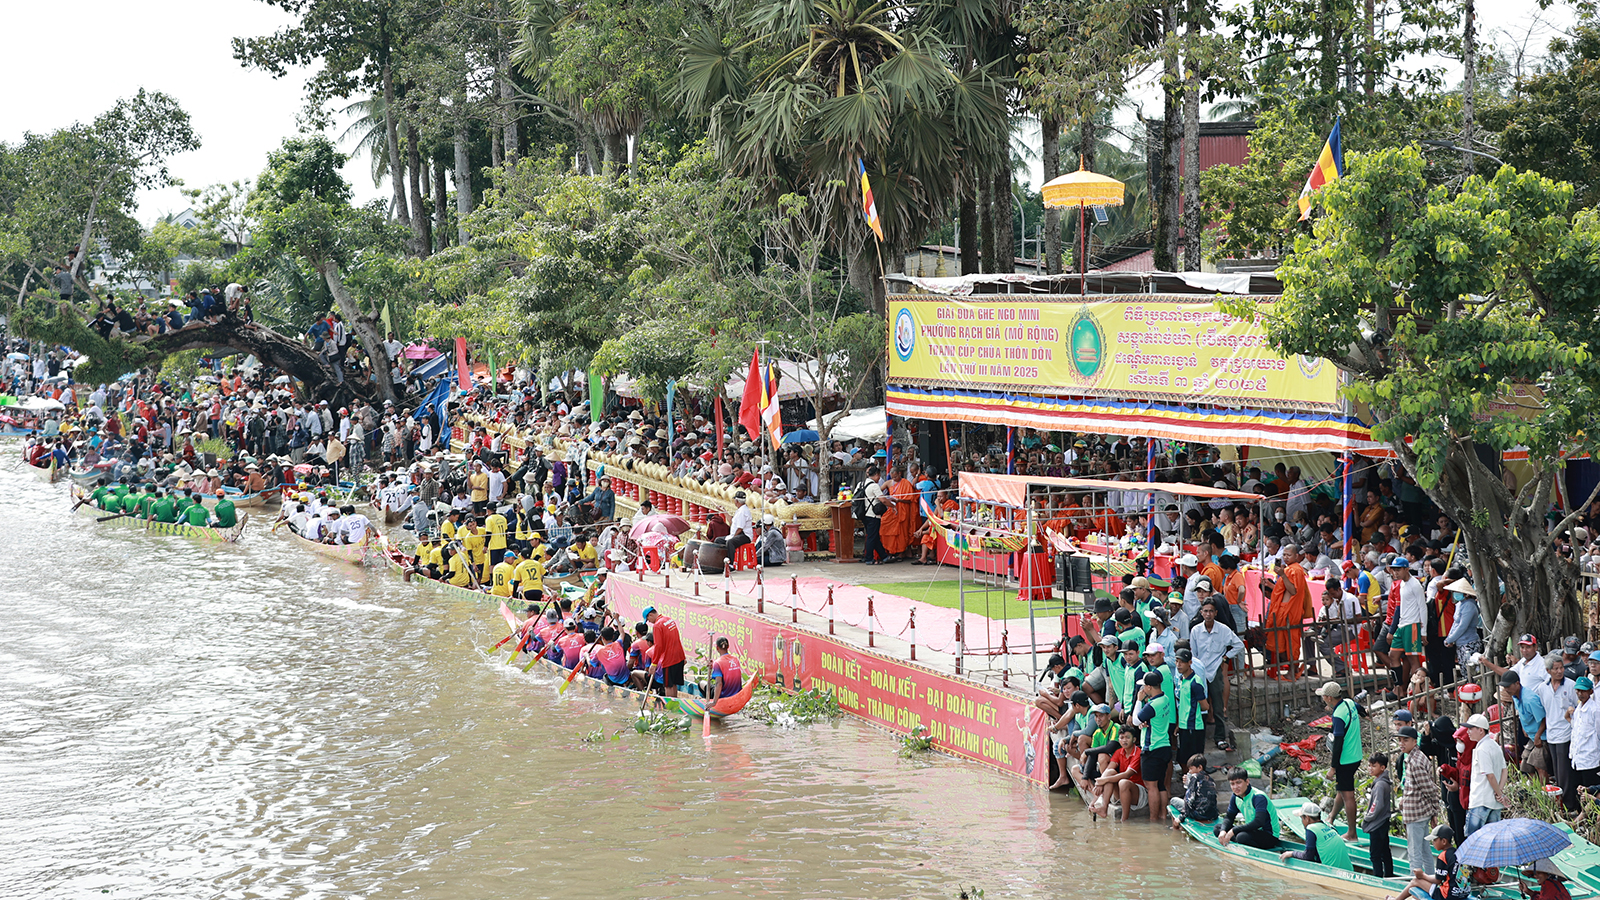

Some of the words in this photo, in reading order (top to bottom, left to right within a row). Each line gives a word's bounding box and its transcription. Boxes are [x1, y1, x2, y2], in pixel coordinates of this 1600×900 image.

[937, 304, 955, 319] GIẢI
[957, 307, 975, 320] ĐUA
[977, 307, 995, 321] GHE
[997, 308, 1016, 321] NGO
[1018, 308, 1040, 321] MINI
[921, 322, 956, 338] PHƯỜNG
[958, 325, 983, 342] RẠCH
[985, 323, 1001, 340] GIÁ
[1004, 322, 1024, 341] (MỞ
[1027, 326, 1059, 344] RỘNG)
[928, 344, 955, 357] TRANH
[958, 344, 975, 358] CÚP
[977, 344, 1001, 359] CHÙA
[1004, 345, 1029, 360] THÔN
[1031, 346, 1052, 361] DÔN
[939, 361, 956, 374] LẦN
[959, 362, 976, 375] THỨ
[978, 364, 988, 376] III
[989, 364, 1011, 377] NĂM
[1013, 366, 1038, 378] 2025
[385, 492, 396, 504] 23
[349, 520, 361, 531] 25
[495, 573, 504, 586] 18
[526, 567, 538, 581] 12
[820, 651, 844, 676] ĐOÀN
[845, 656, 862, 682] KẾT
[870, 669, 896, 694] ĐOÀN
[898, 675, 917, 701] KẾT
[926, 687, 944, 713] ĐẠI
[946, 692, 975, 720] ĐOÀN
[976, 700, 1001, 729] KẾT.
[838, 684, 859, 711] CÔNG
[866, 697, 895, 724] THÀNH
[930, 718, 947, 745] ĐẠI
[948, 722, 980, 754] THÀNH
[982, 736, 1013, 766] CÔNG.
